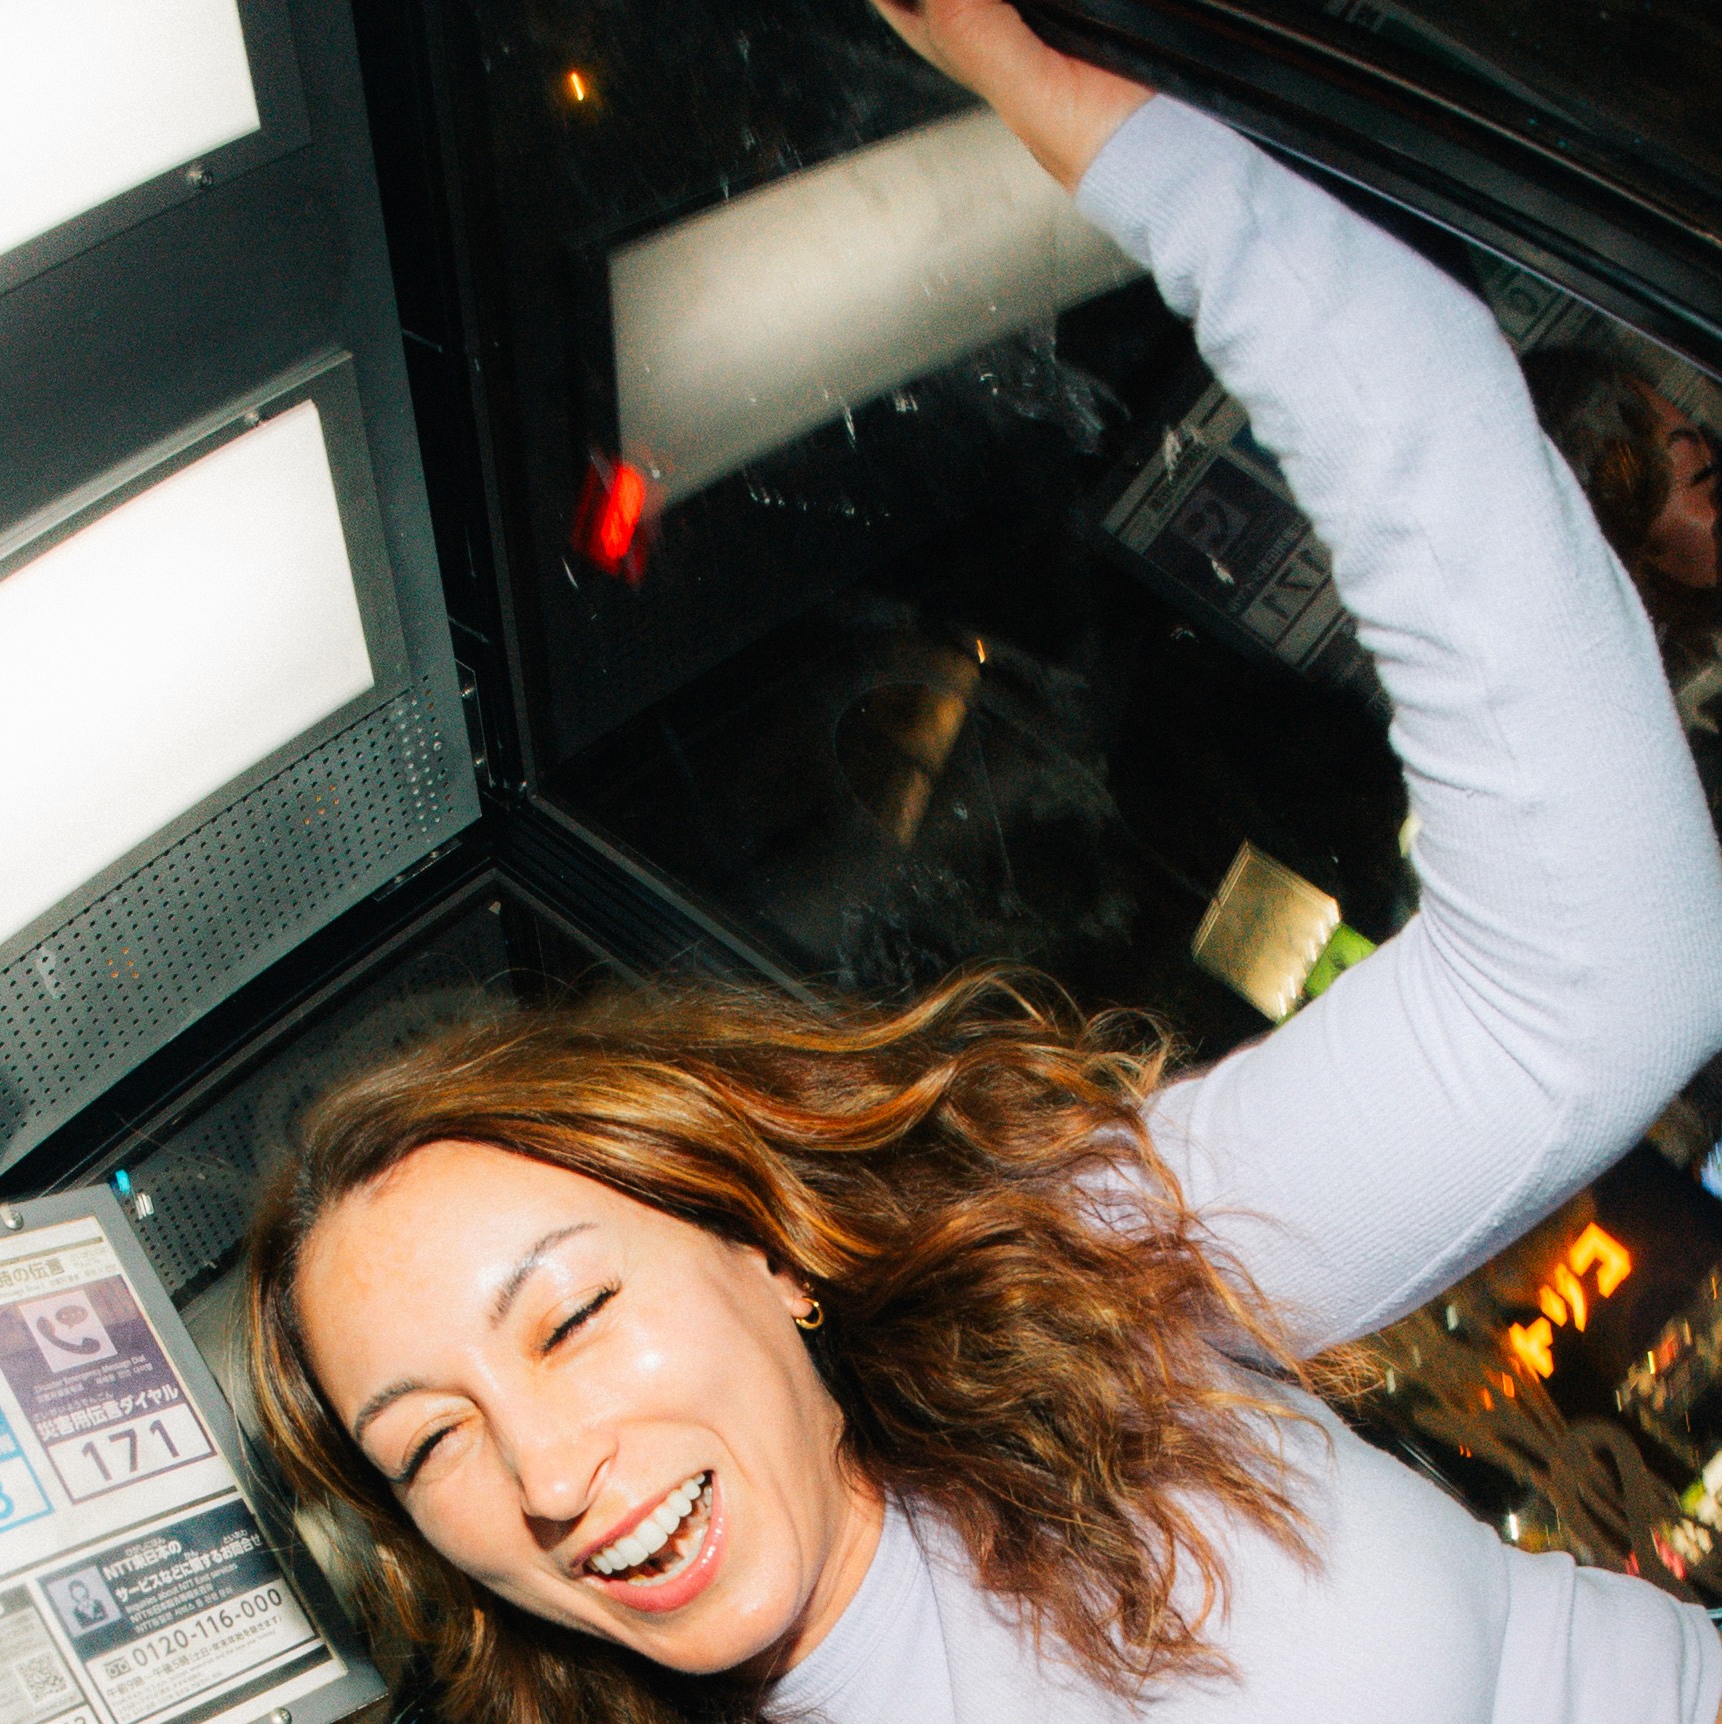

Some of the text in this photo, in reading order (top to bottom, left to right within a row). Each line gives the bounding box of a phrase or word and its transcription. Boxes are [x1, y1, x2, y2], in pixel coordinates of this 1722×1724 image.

[35, 1384, 178, 1442] 災害用伝言ダイヤル
[81, 1419, 179, 1480] 171
[102, 1540, 181, 1580] NTT東日本の
[132, 1583, 285, 1664] 0120-116-000
